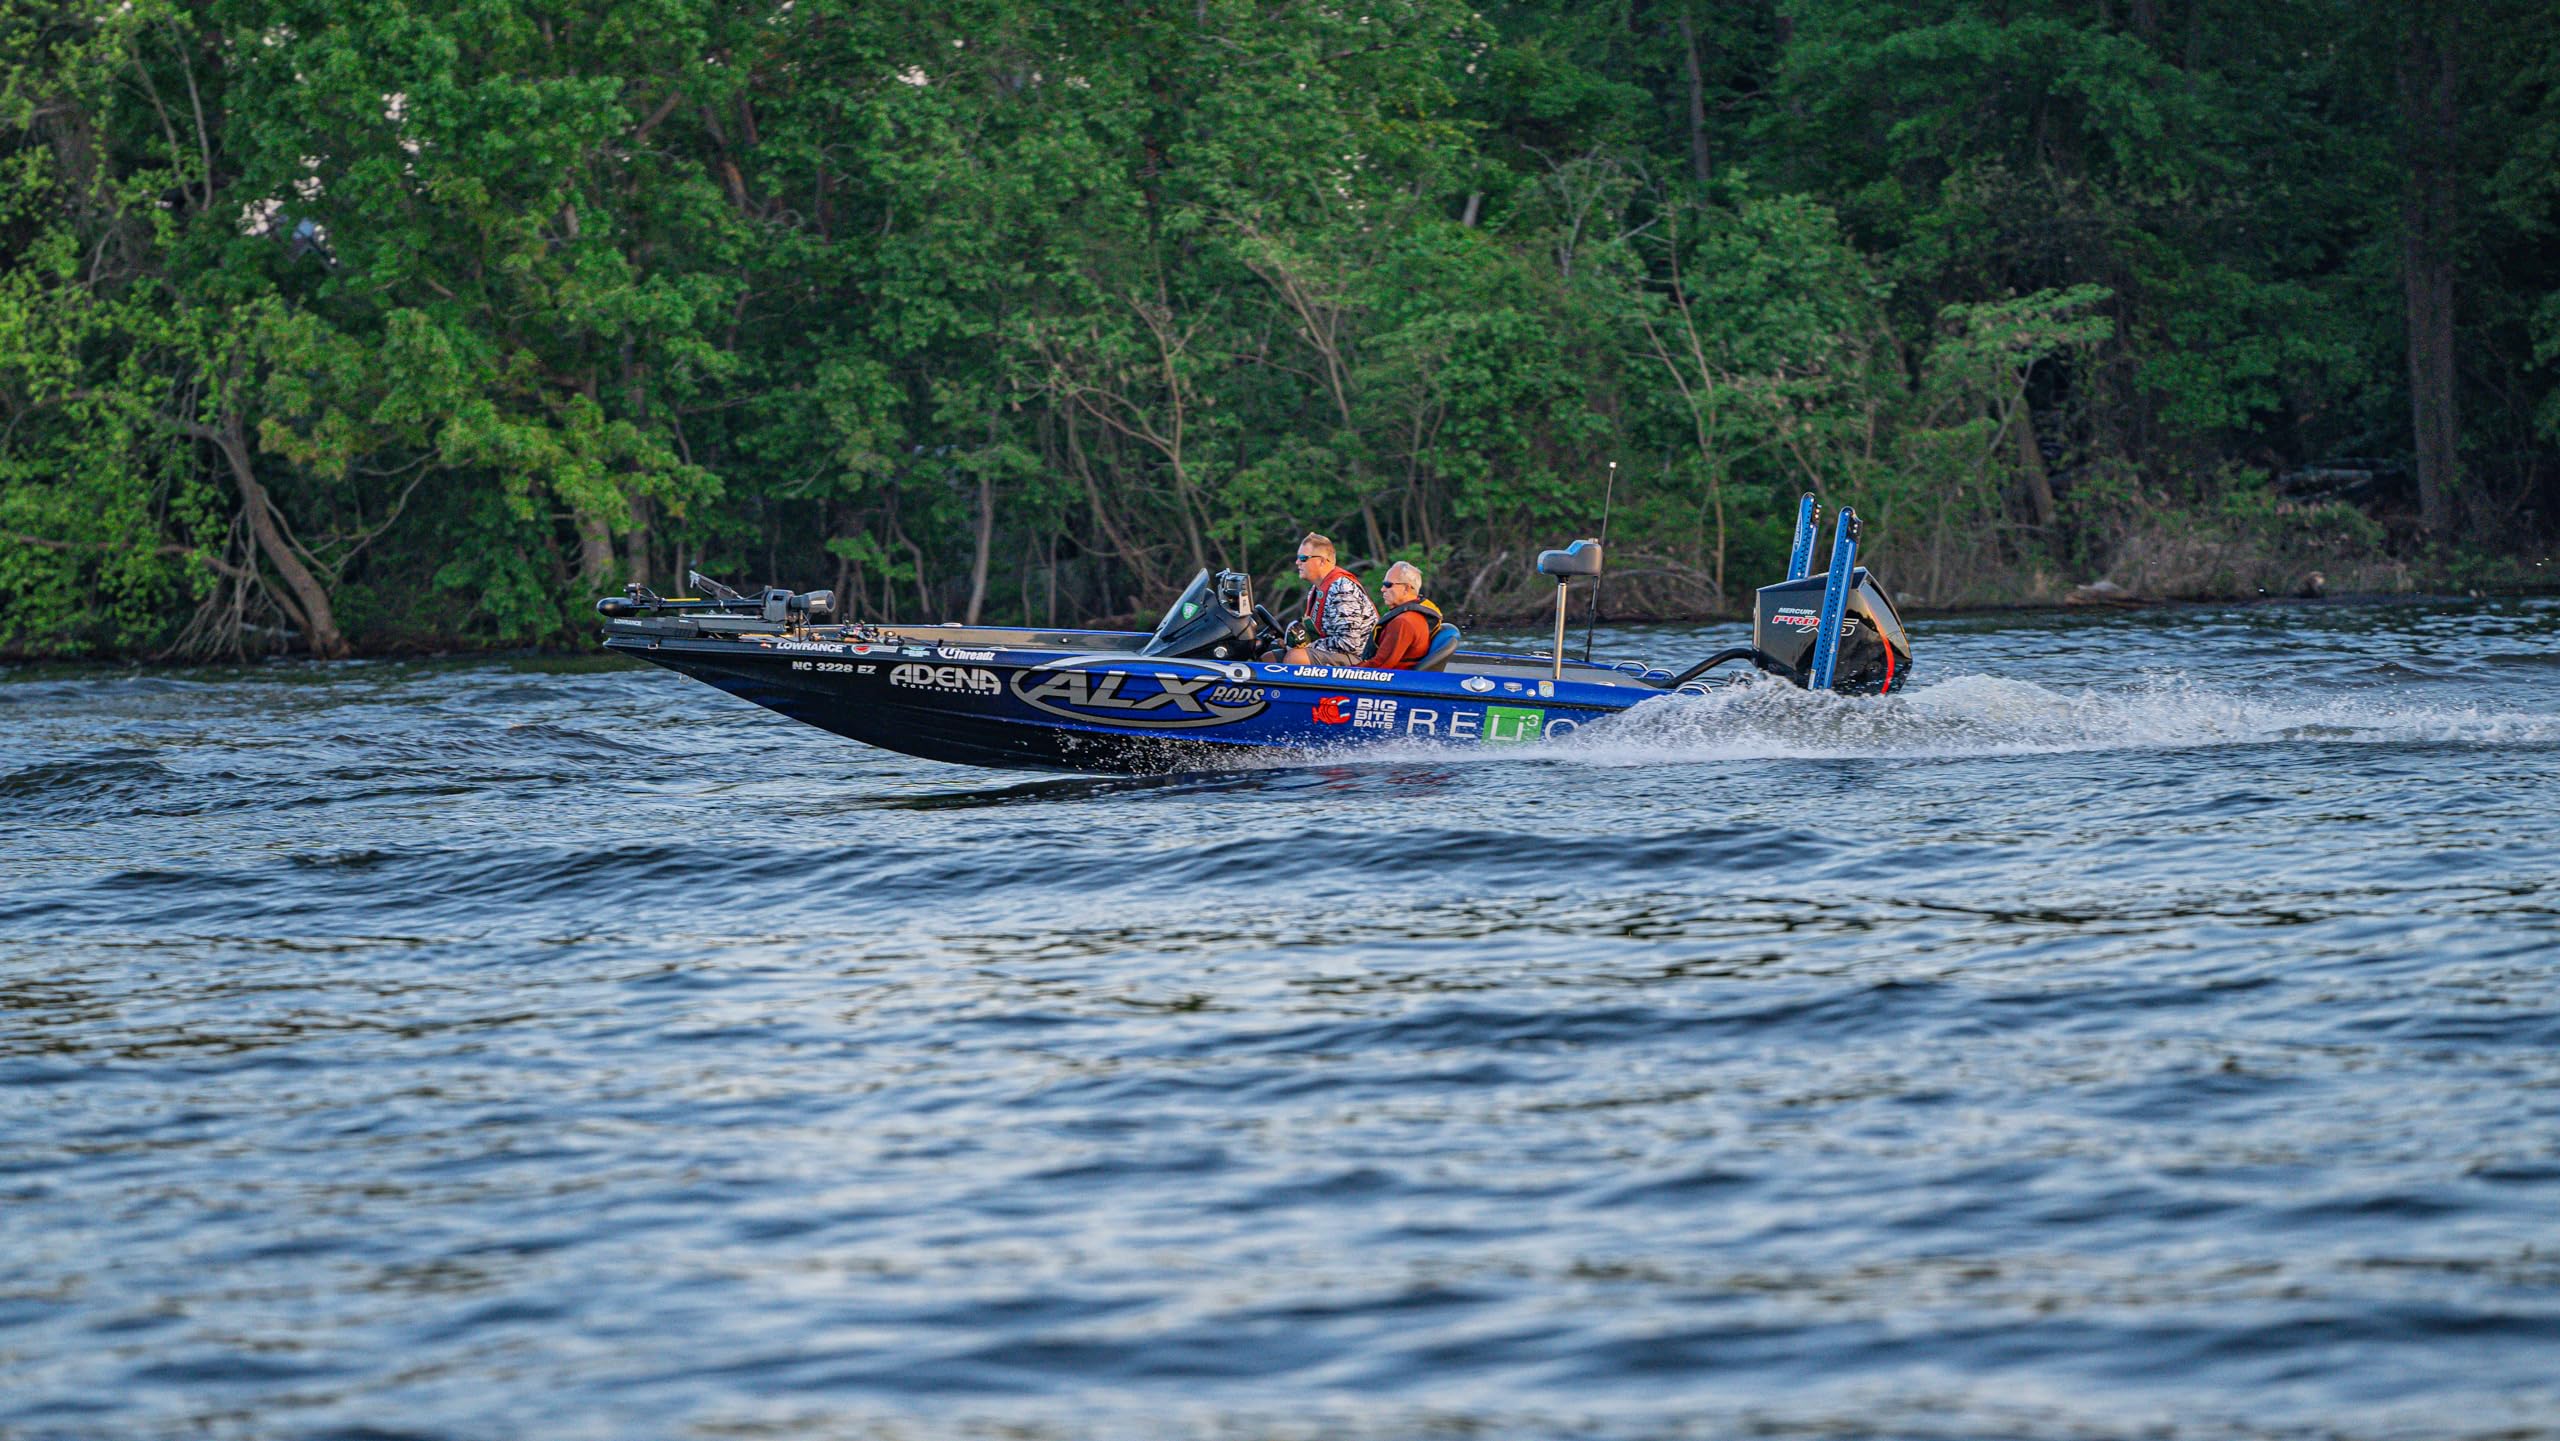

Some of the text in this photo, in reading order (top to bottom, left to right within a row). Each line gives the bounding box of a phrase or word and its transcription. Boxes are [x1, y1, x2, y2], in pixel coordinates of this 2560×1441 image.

[1778, 607, 1816, 615] MERCURY
[1771, 615, 1820, 626] PRO
[776, 641, 844, 653] LOWRANCE
[792, 661, 877, 675] NC 3228 EZ
[1293, 665, 1395, 682] Jake Whitaker
[889, 663, 1002, 695] ADENA
[902, 683, 990, 696] CORPORATION
[1023, 669, 1224, 712] ALX
[1209, 685, 1265, 704] RODS
[1356, 698, 1398, 712] BIG
[1354, 709, 1396, 722] BITE
[1353, 720, 1393, 730] BAITS
